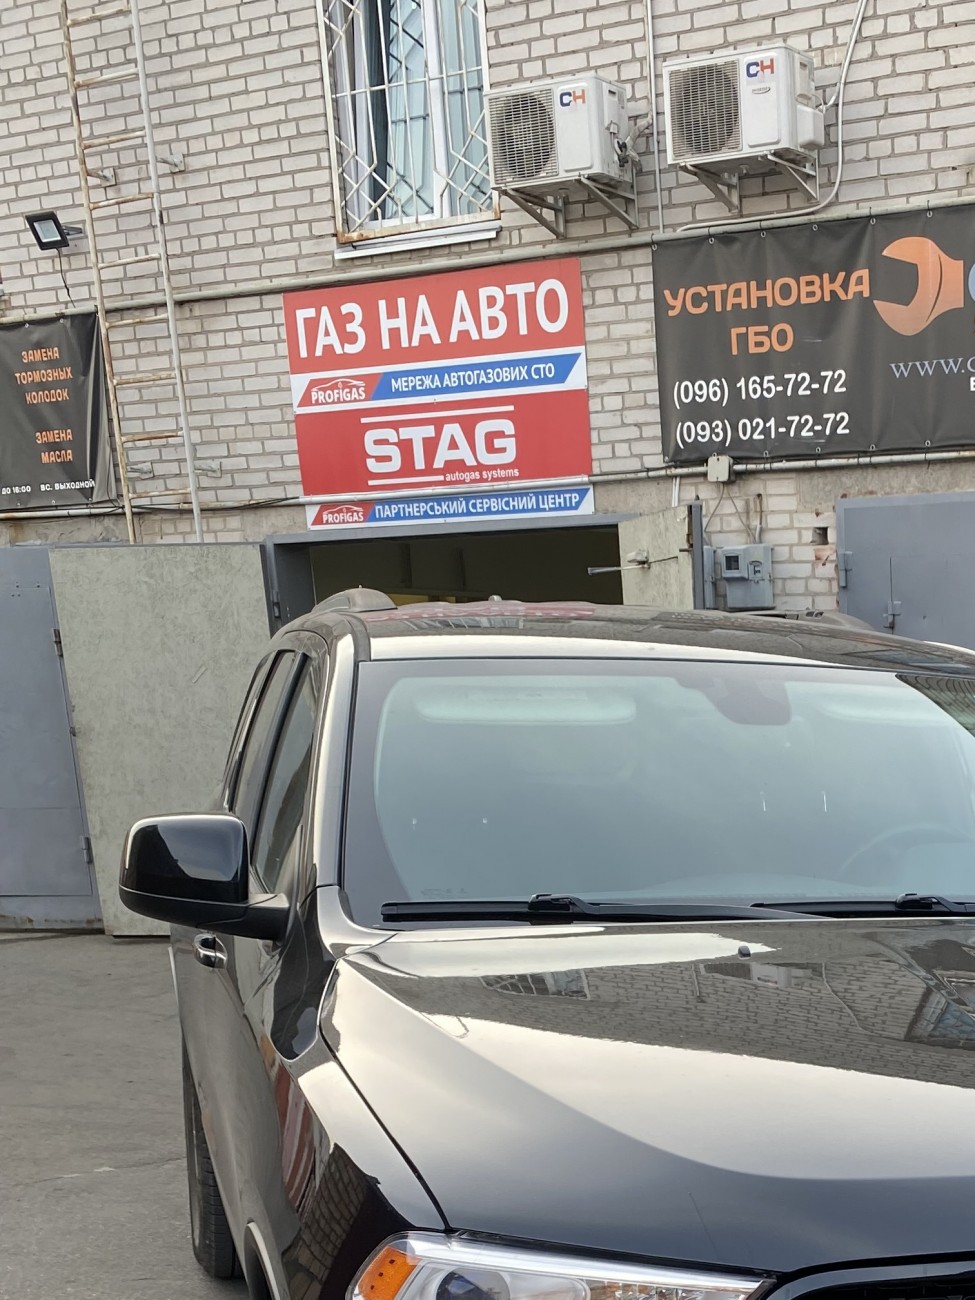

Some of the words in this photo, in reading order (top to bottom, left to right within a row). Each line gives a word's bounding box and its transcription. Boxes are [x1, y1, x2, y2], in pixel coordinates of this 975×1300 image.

[746, 58, 774, 78] CH
[560, 88, 586, 107] CH
[664, 268, 870, 316] УСТАНОВКА
[296, 302, 366, 358] ГАЗ
[378, 295, 441, 350] НА
[450, 279, 569, 342] АВТО
[731, 323, 794, 355] ГБО
[22, 347, 59, 363] ЗАМЕНА
[15, 366, 73, 385] ТОРМОЗНЫХ
[391, 374, 441, 392] МЕРЕЖА
[443, 366, 528, 388] АВТОГАЗОВИХ
[530, 362, 554, 379] СТО
[26, 388, 69, 404] КОЛОДОК
[674, 378, 728, 409] (096)
[736, 370, 846, 400] 165-72-72
[36, 429, 72, 444] ЗАМЕНА
[676, 419, 731, 449] (093)
[738, 412, 849, 440] 021-72-72
[364, 419, 516, 473] STAG
[41, 450, 72, 464] МАСЛА
[54, 478, 95, 490] ВЫХОДНОЙ
[446, 470, 480, 483] autogas
[482, 468, 520, 480] systems
[375, 500, 470, 518] ПАРТНЕРСЬКИЙ
[471, 496, 538, 514] СЕРВІСНИЙ
[540, 494, 580, 510] ЦЕНТР
